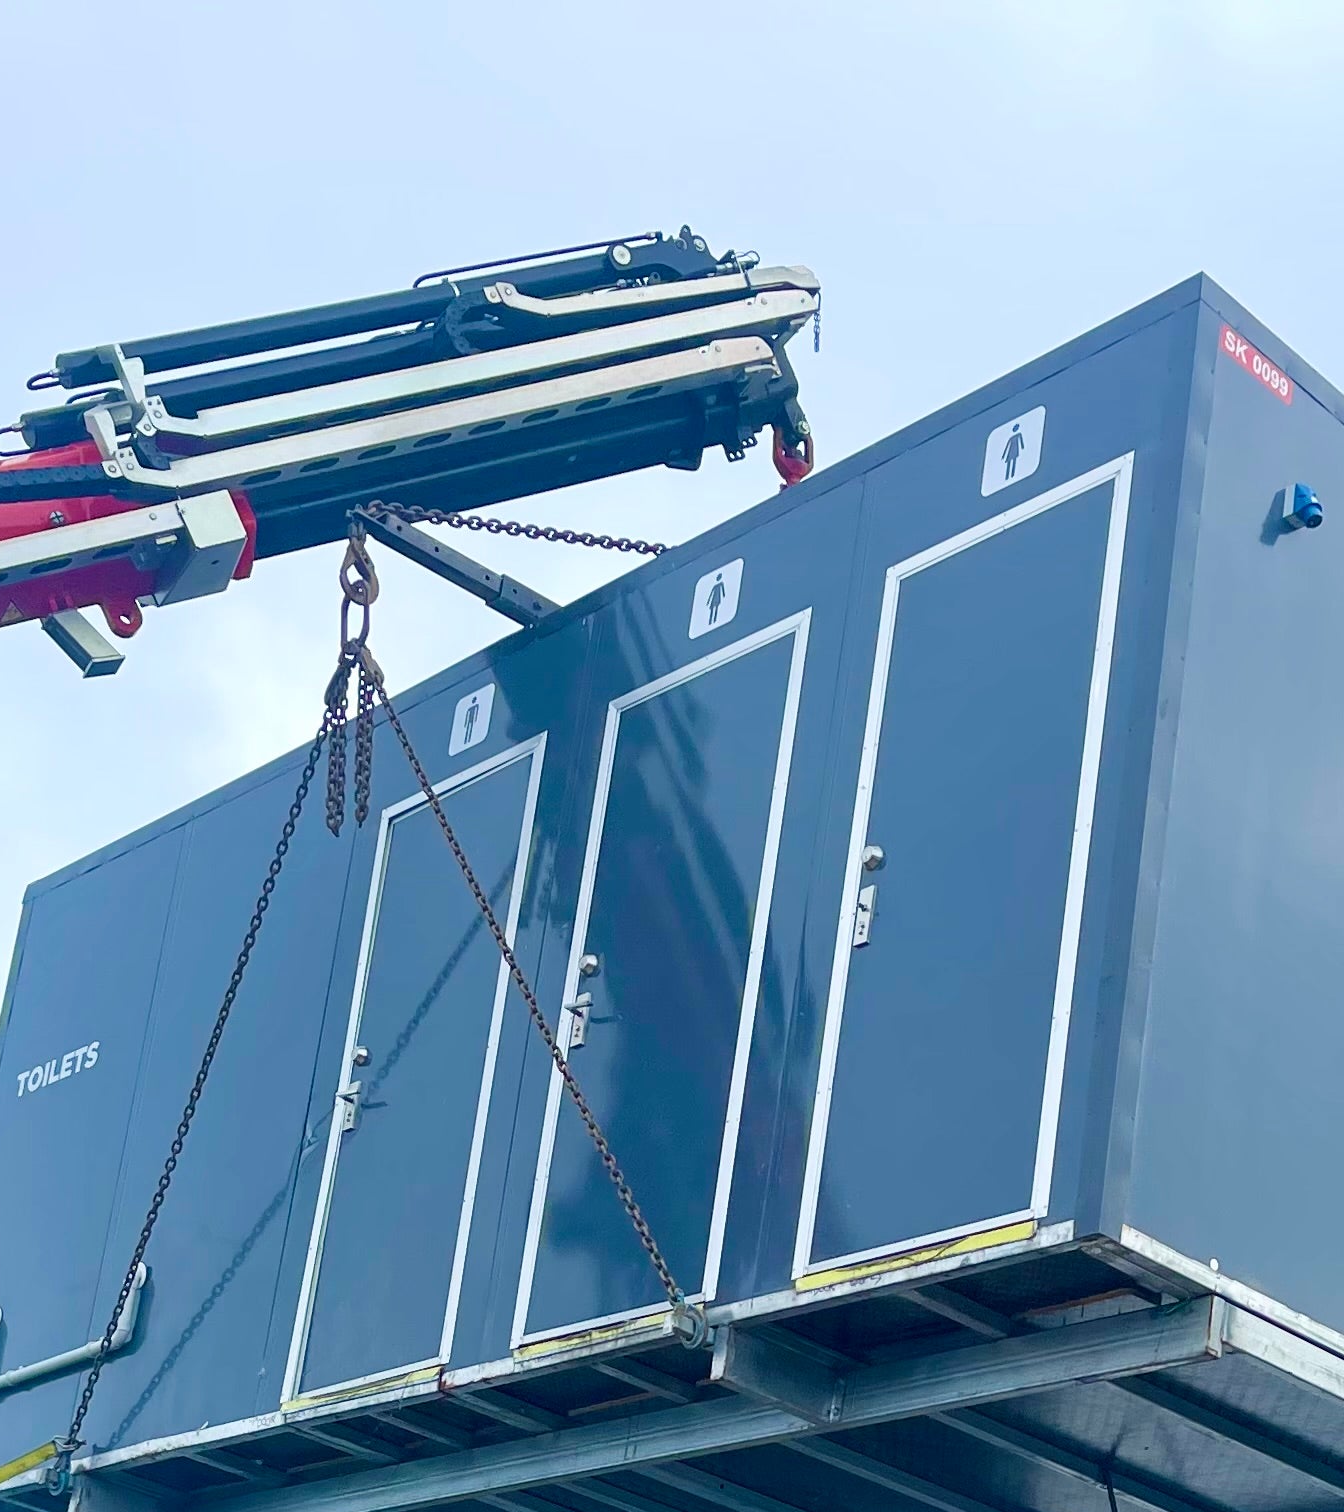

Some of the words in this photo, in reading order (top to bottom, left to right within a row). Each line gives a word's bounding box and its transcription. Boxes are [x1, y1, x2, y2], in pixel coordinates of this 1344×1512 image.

[1224, 330, 1247, 364] SK
[1253, 355, 1289, 396] 0099
[17, 1041, 100, 1097] TOILETS
